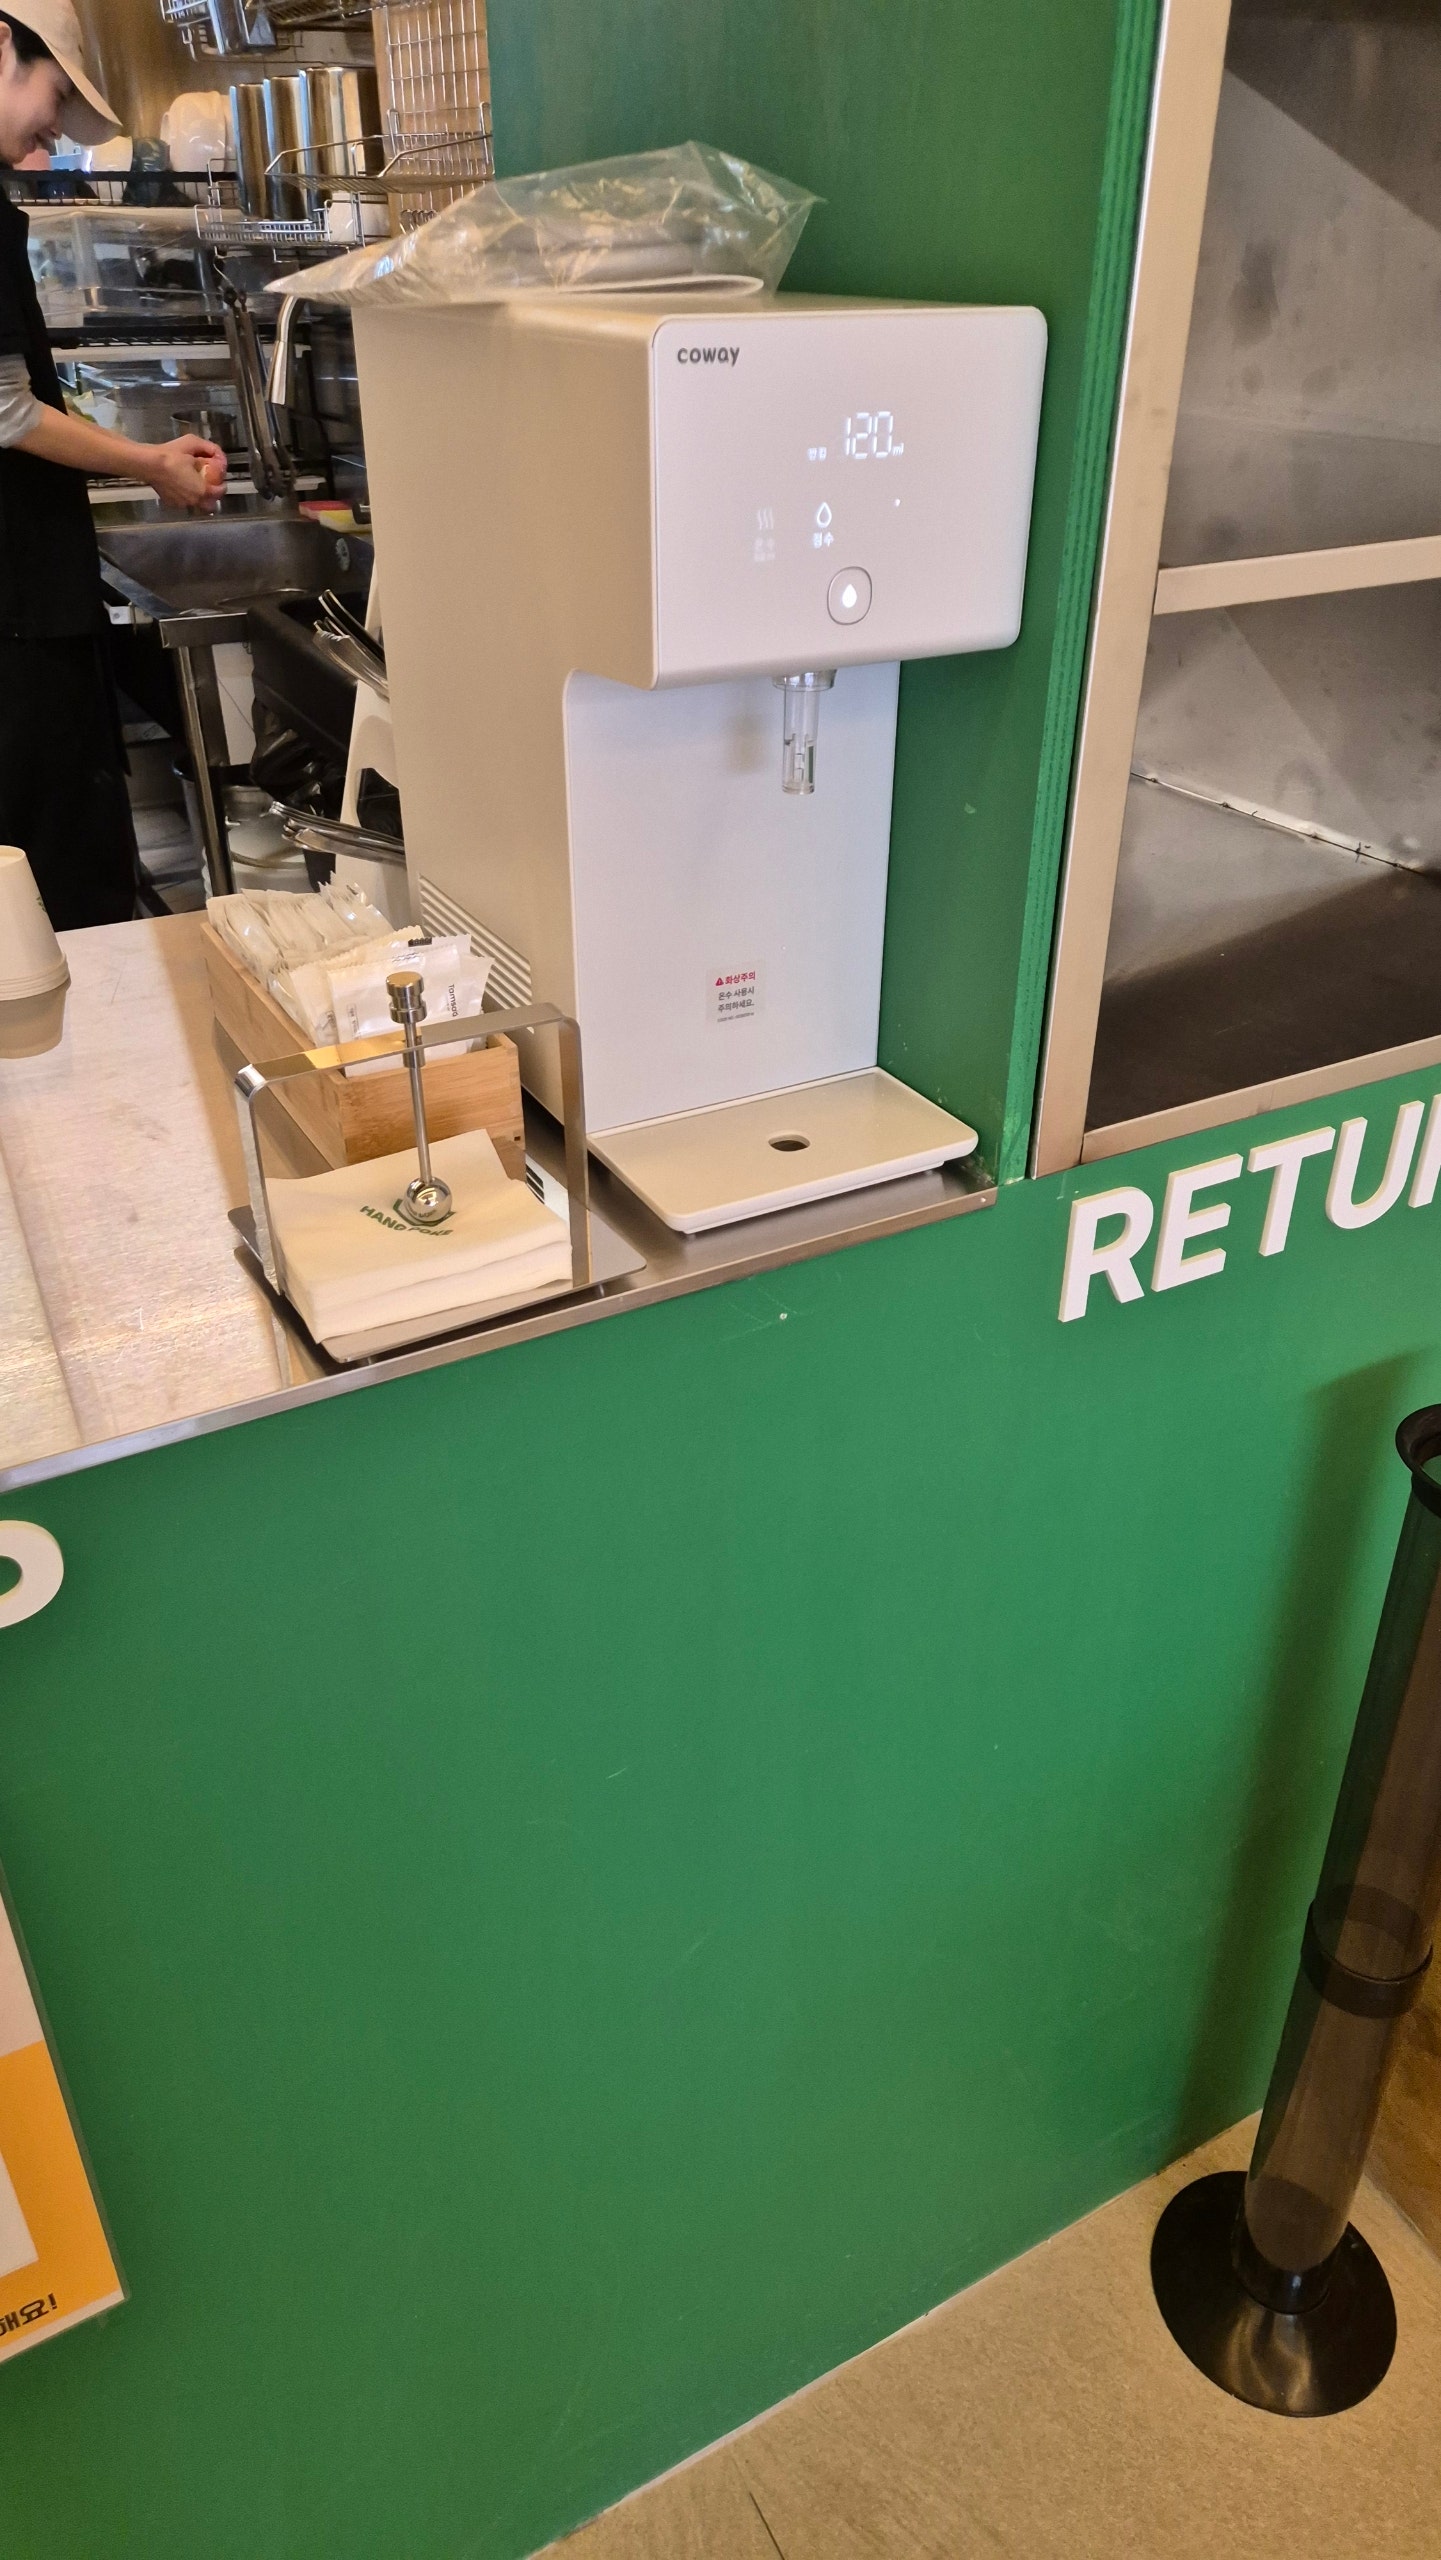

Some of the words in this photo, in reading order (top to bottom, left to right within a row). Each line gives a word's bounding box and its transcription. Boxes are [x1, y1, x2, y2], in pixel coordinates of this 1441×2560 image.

[677, 346, 740, 367] coway
[725, 971, 756, 985] 화상주의
[718, 991, 732, 1001] 온수
